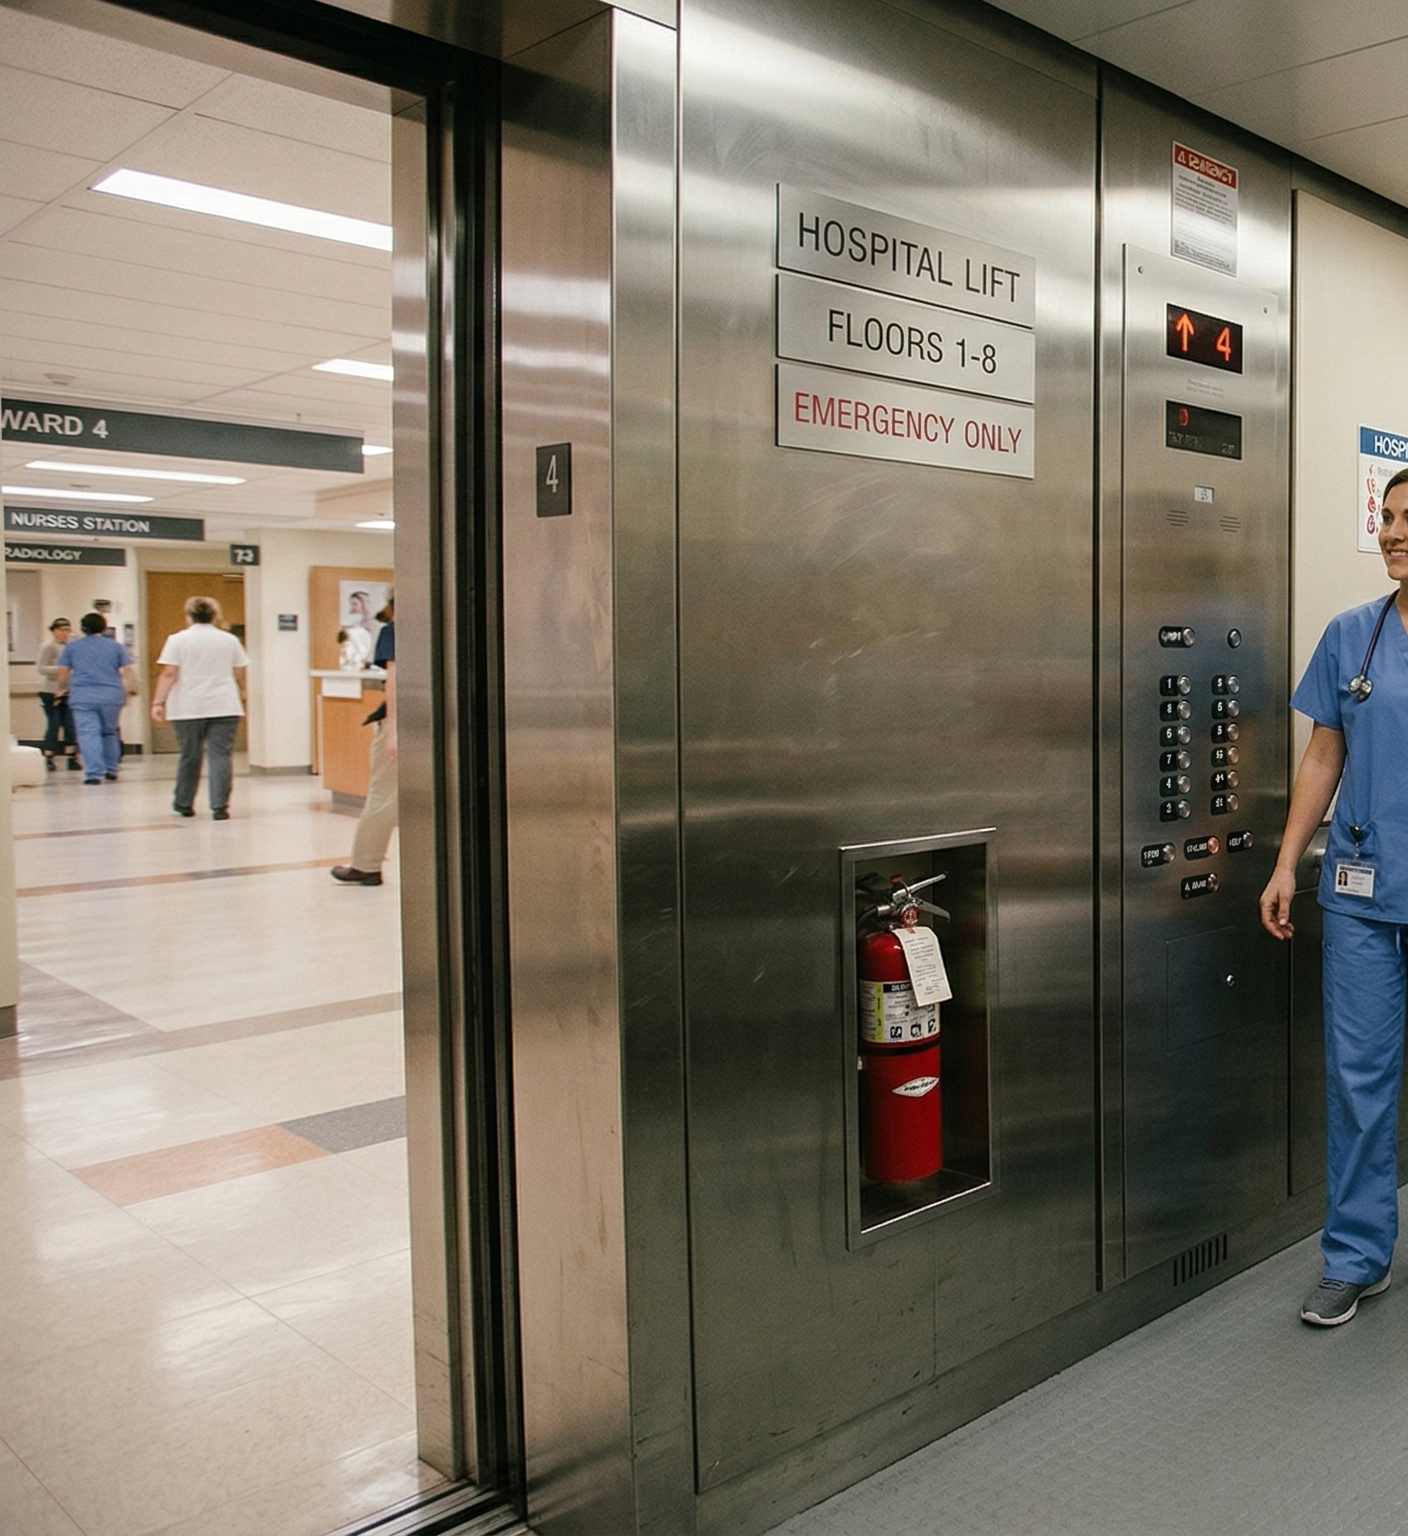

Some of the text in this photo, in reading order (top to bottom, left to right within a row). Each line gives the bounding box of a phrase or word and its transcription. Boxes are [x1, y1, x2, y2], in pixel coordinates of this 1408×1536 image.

[799, 212, 1020, 303] HOSPITAL LIFT
[828, 309, 997, 374] FLOORS 1-8
[1216, 326, 1232, 362] 4
[1, 409, 109, 439] WARD 4
[795, 392, 1022, 454] EMERGENCY ONLY
[546, 454, 559, 493] 4
[11, 512, 150, 533] NURSES STATION
[5, 547, 82, 561] RADIOLOGY
[1166, 754, 1172, 765] 7
